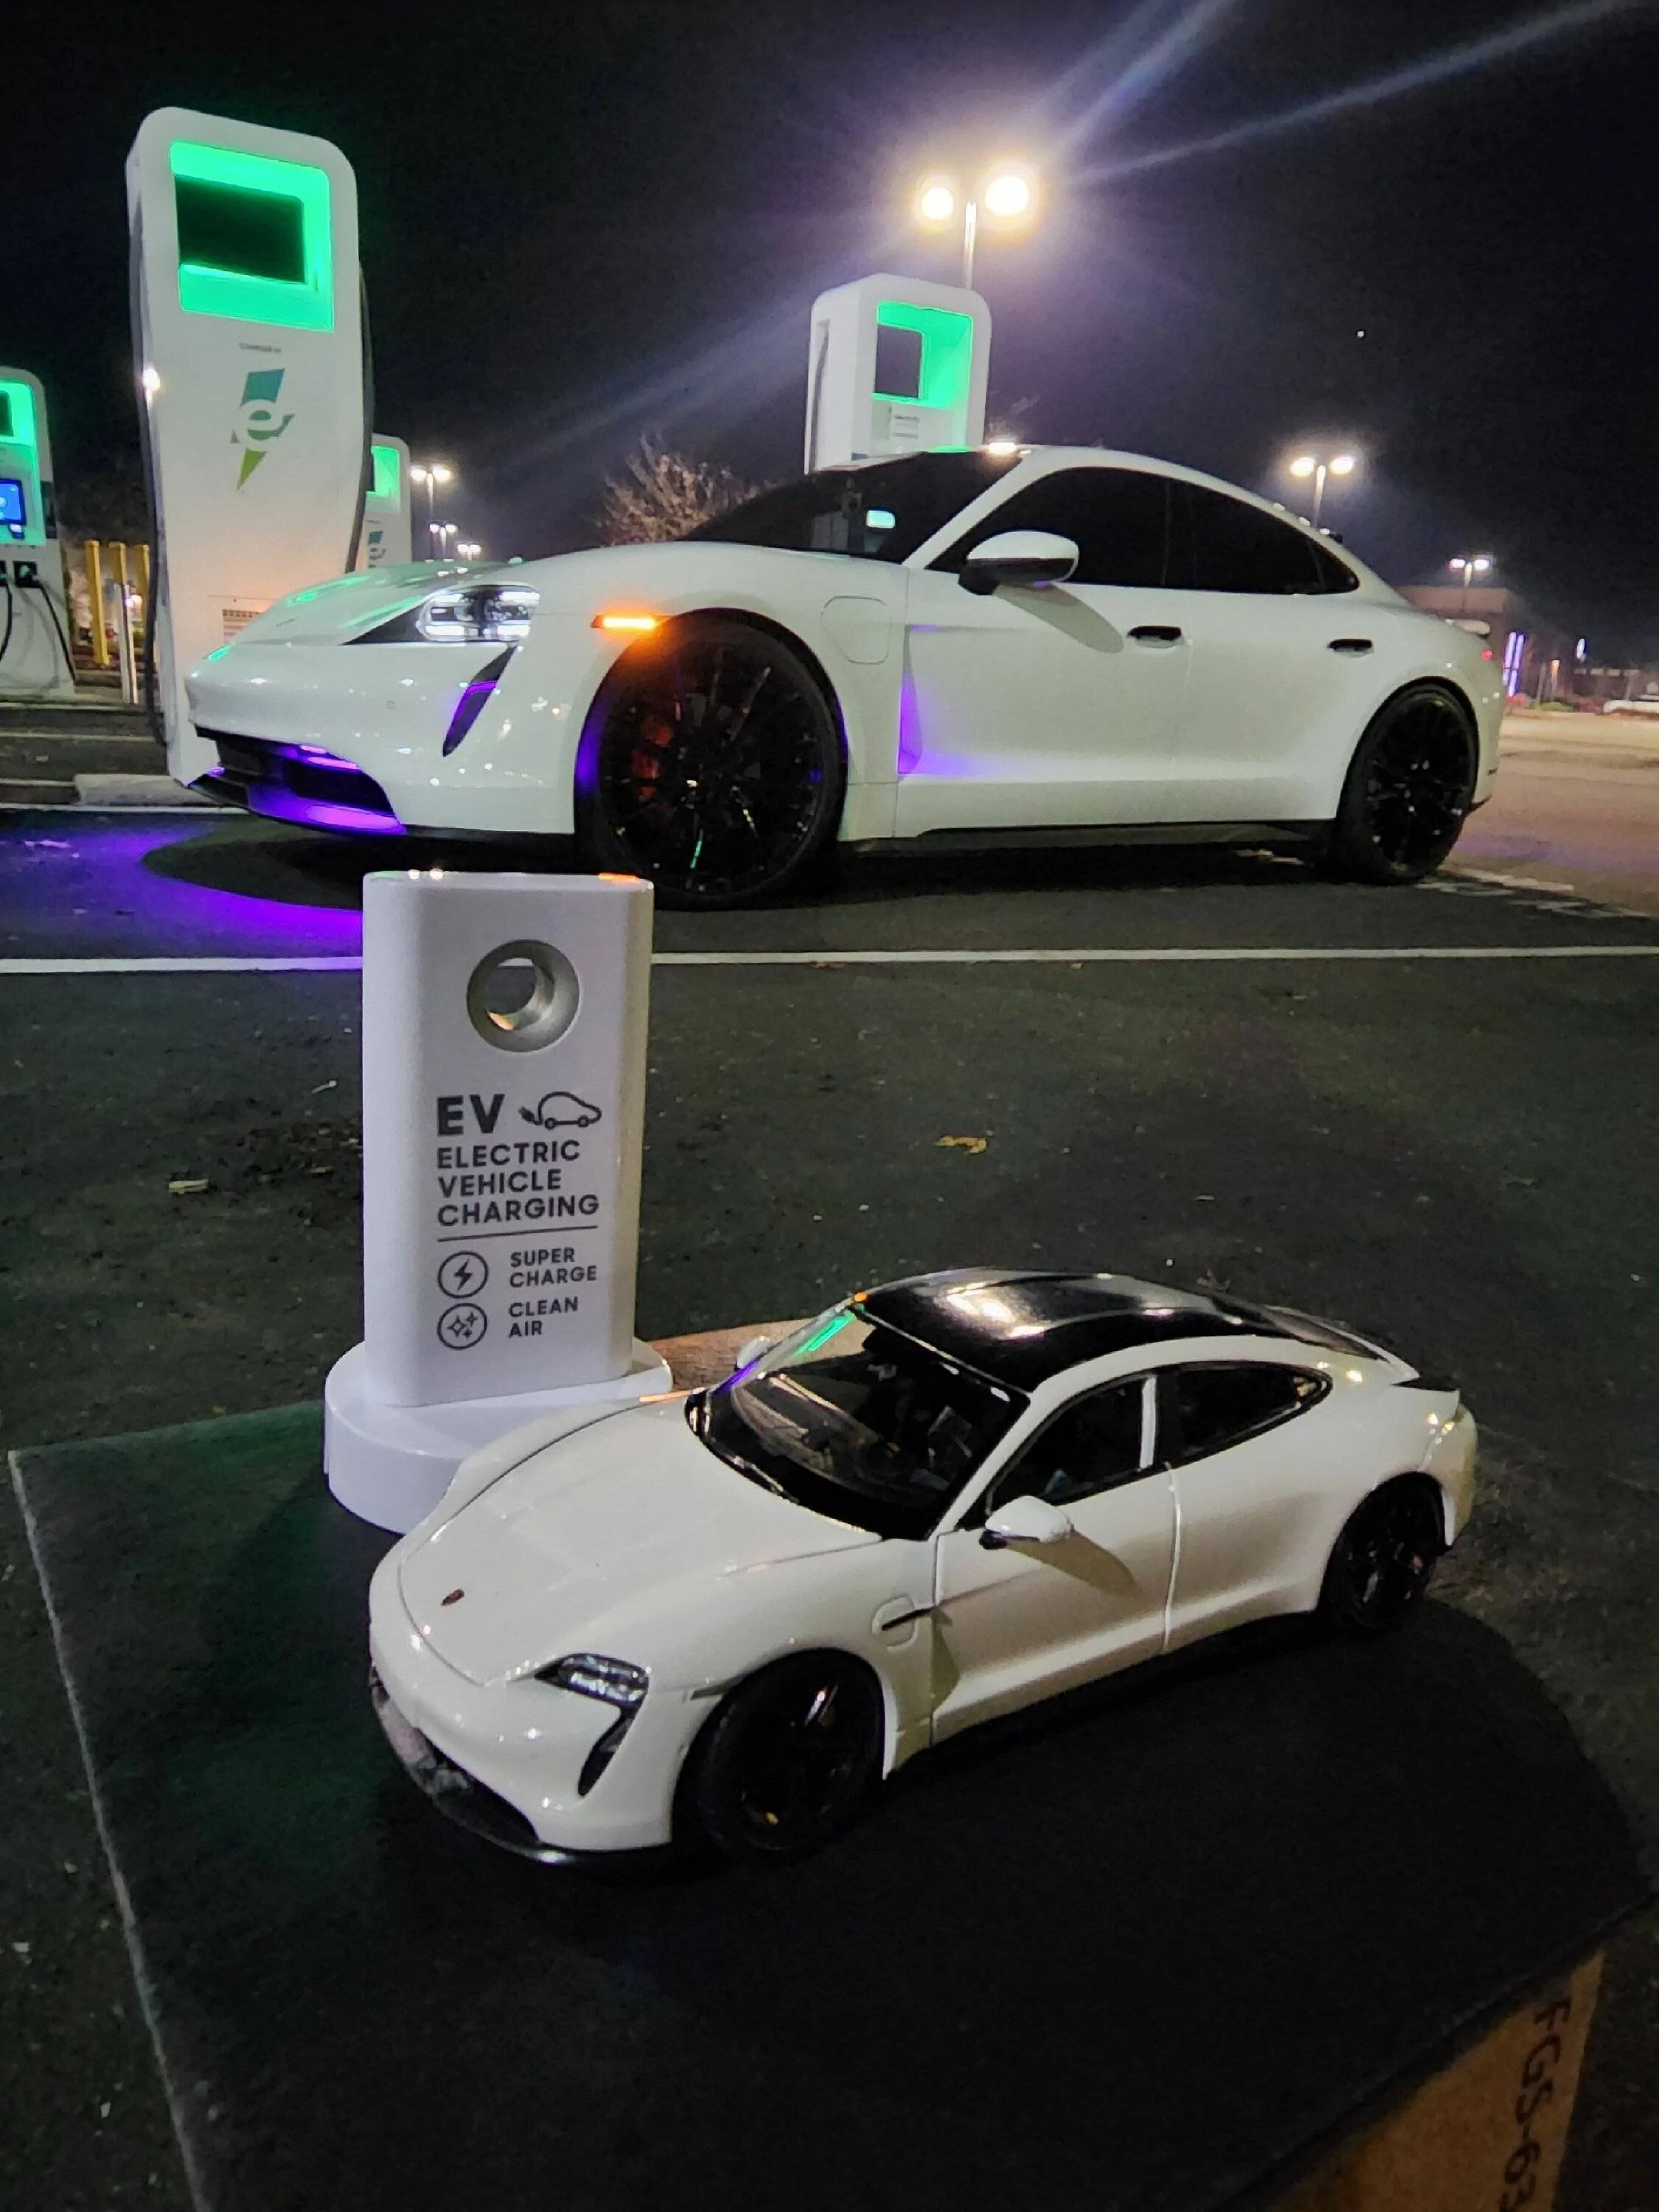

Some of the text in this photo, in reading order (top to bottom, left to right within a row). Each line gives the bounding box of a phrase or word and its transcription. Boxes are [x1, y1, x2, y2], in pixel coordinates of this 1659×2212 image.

[437, 1093, 506, 1137] EV
[437, 1139, 580, 1169] ELECTRIC
[437, 1168, 562, 1199] VEHICLE
[437, 1194, 599, 1227] CHARGING
[509, 1246, 575, 1268] SUPER
[509, 1265, 597, 1288] CHARGE
[508, 1295, 579, 1318] CLEAN
[507, 1320, 543, 1339] AIR
